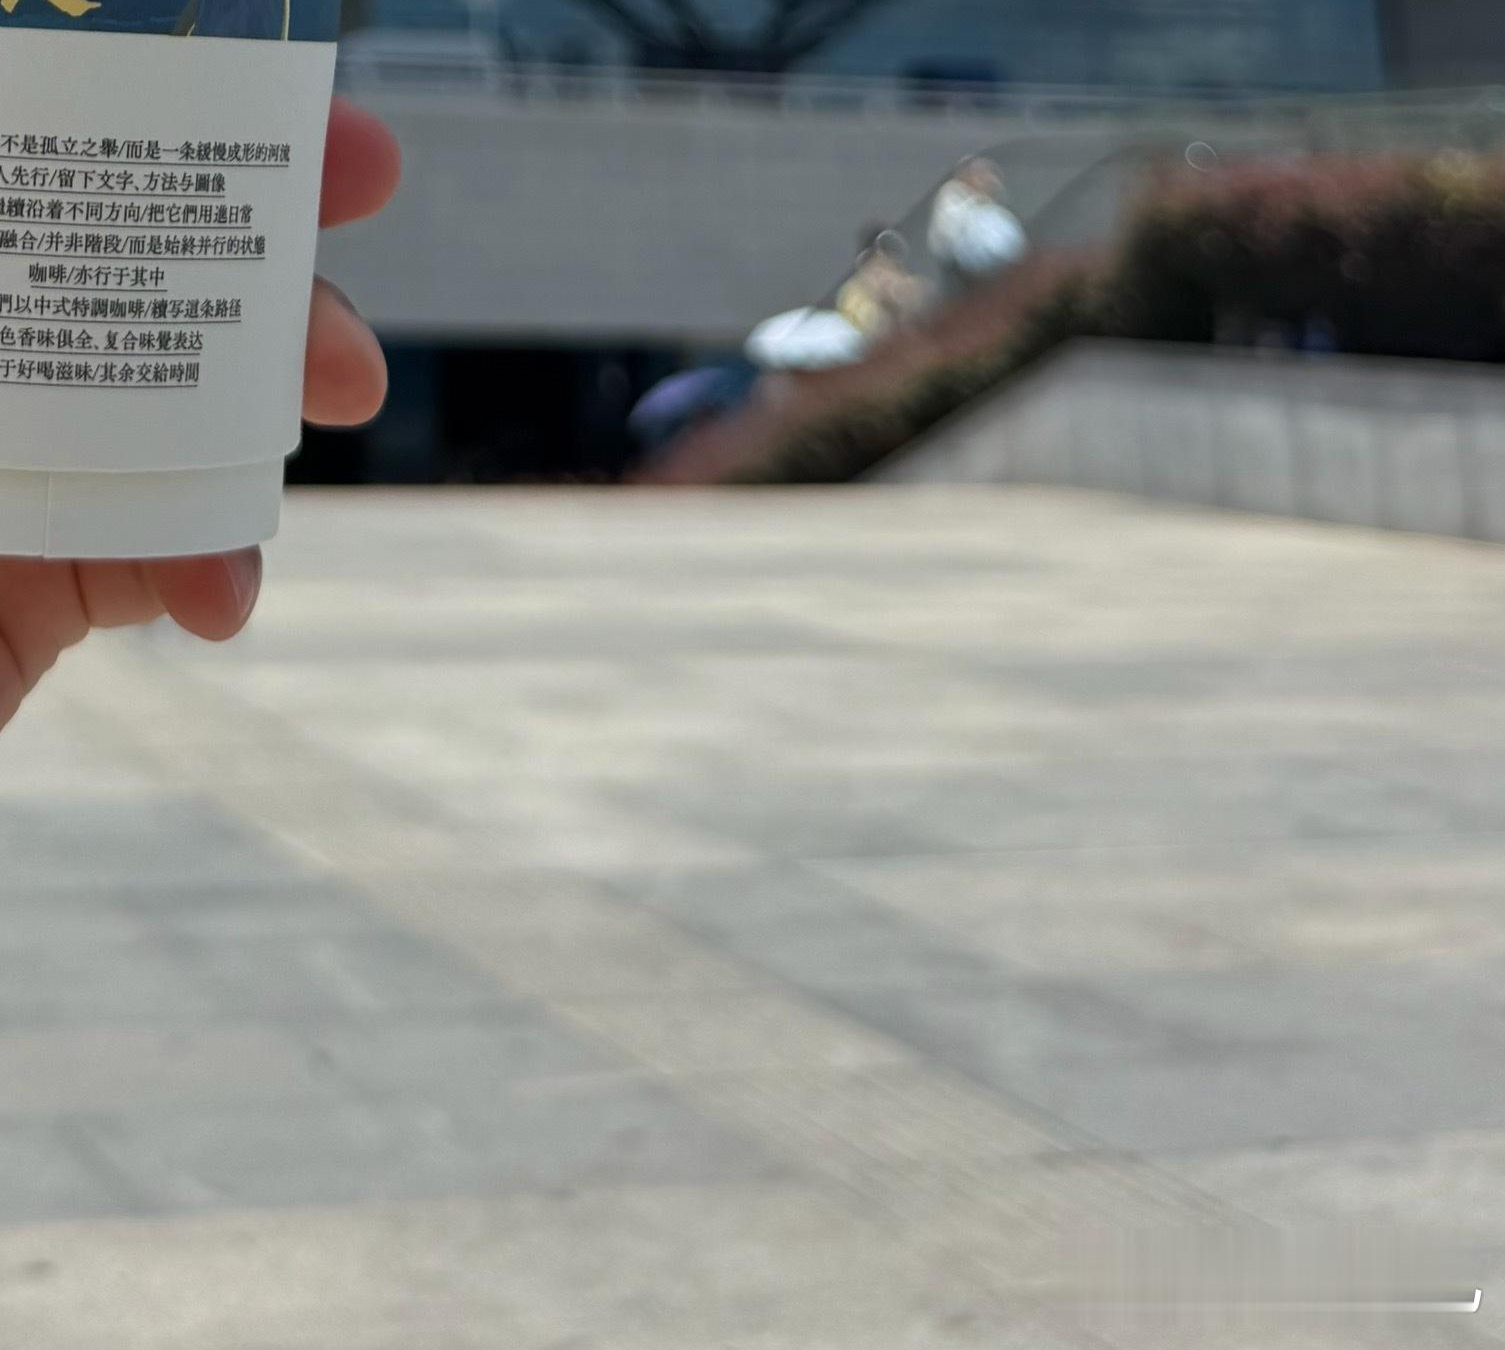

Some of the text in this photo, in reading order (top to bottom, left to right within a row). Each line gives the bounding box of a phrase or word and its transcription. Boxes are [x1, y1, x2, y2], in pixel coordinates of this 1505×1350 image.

[28, 263, 165, 287] 咖啡/亦行于其中
